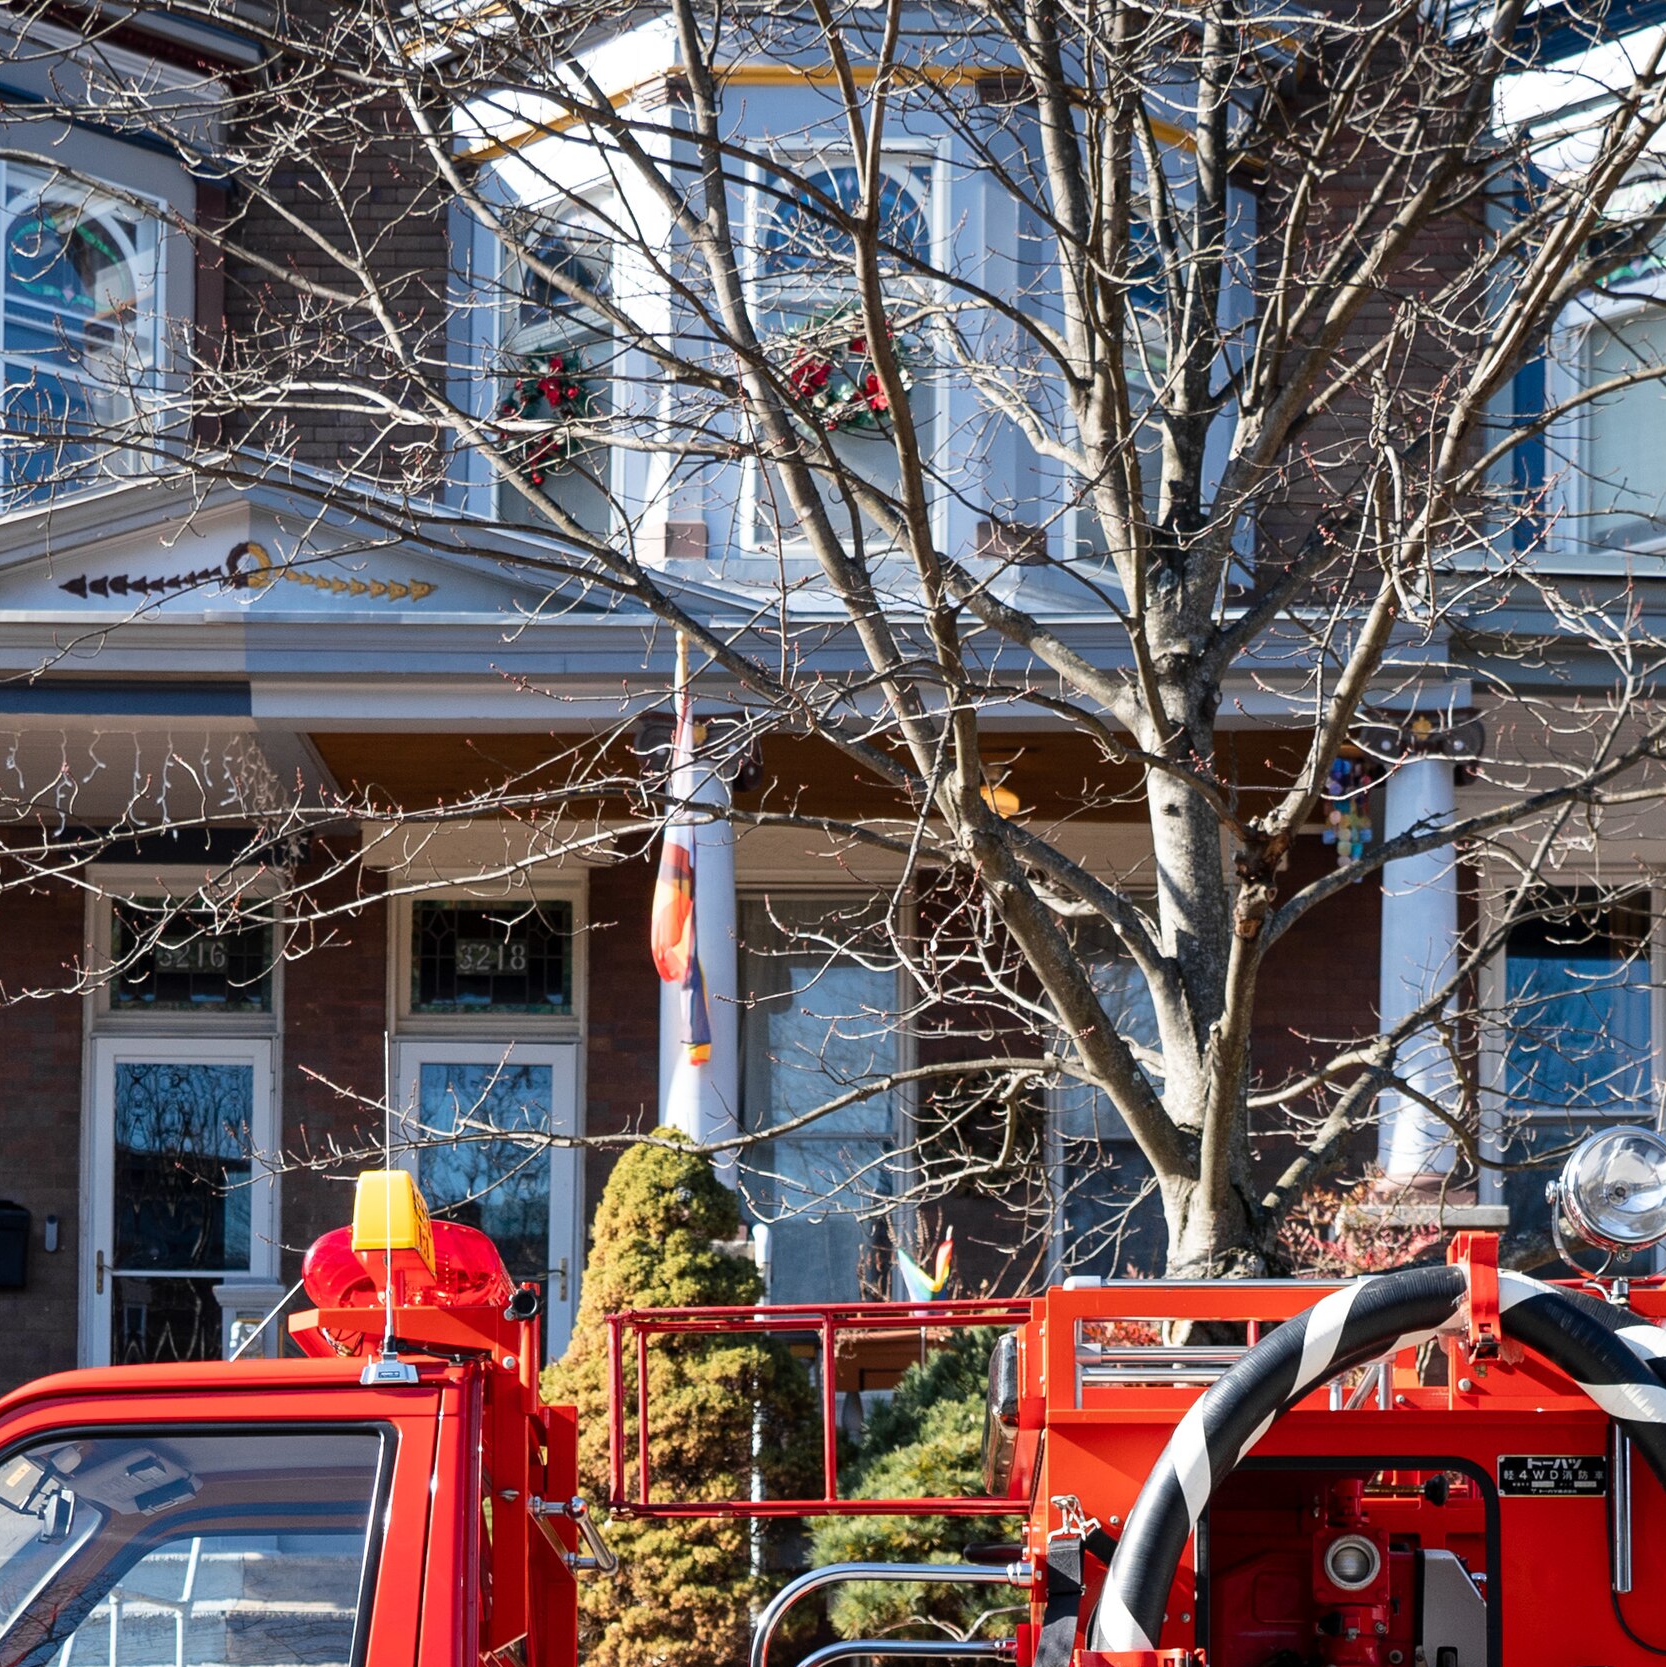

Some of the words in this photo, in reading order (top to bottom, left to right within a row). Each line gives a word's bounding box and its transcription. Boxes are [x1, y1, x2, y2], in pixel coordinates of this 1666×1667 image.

[158, 942, 225, 968] 3216
[459, 944, 526, 970] 3218
[1527, 1458, 1582, 1469] トーハツ
